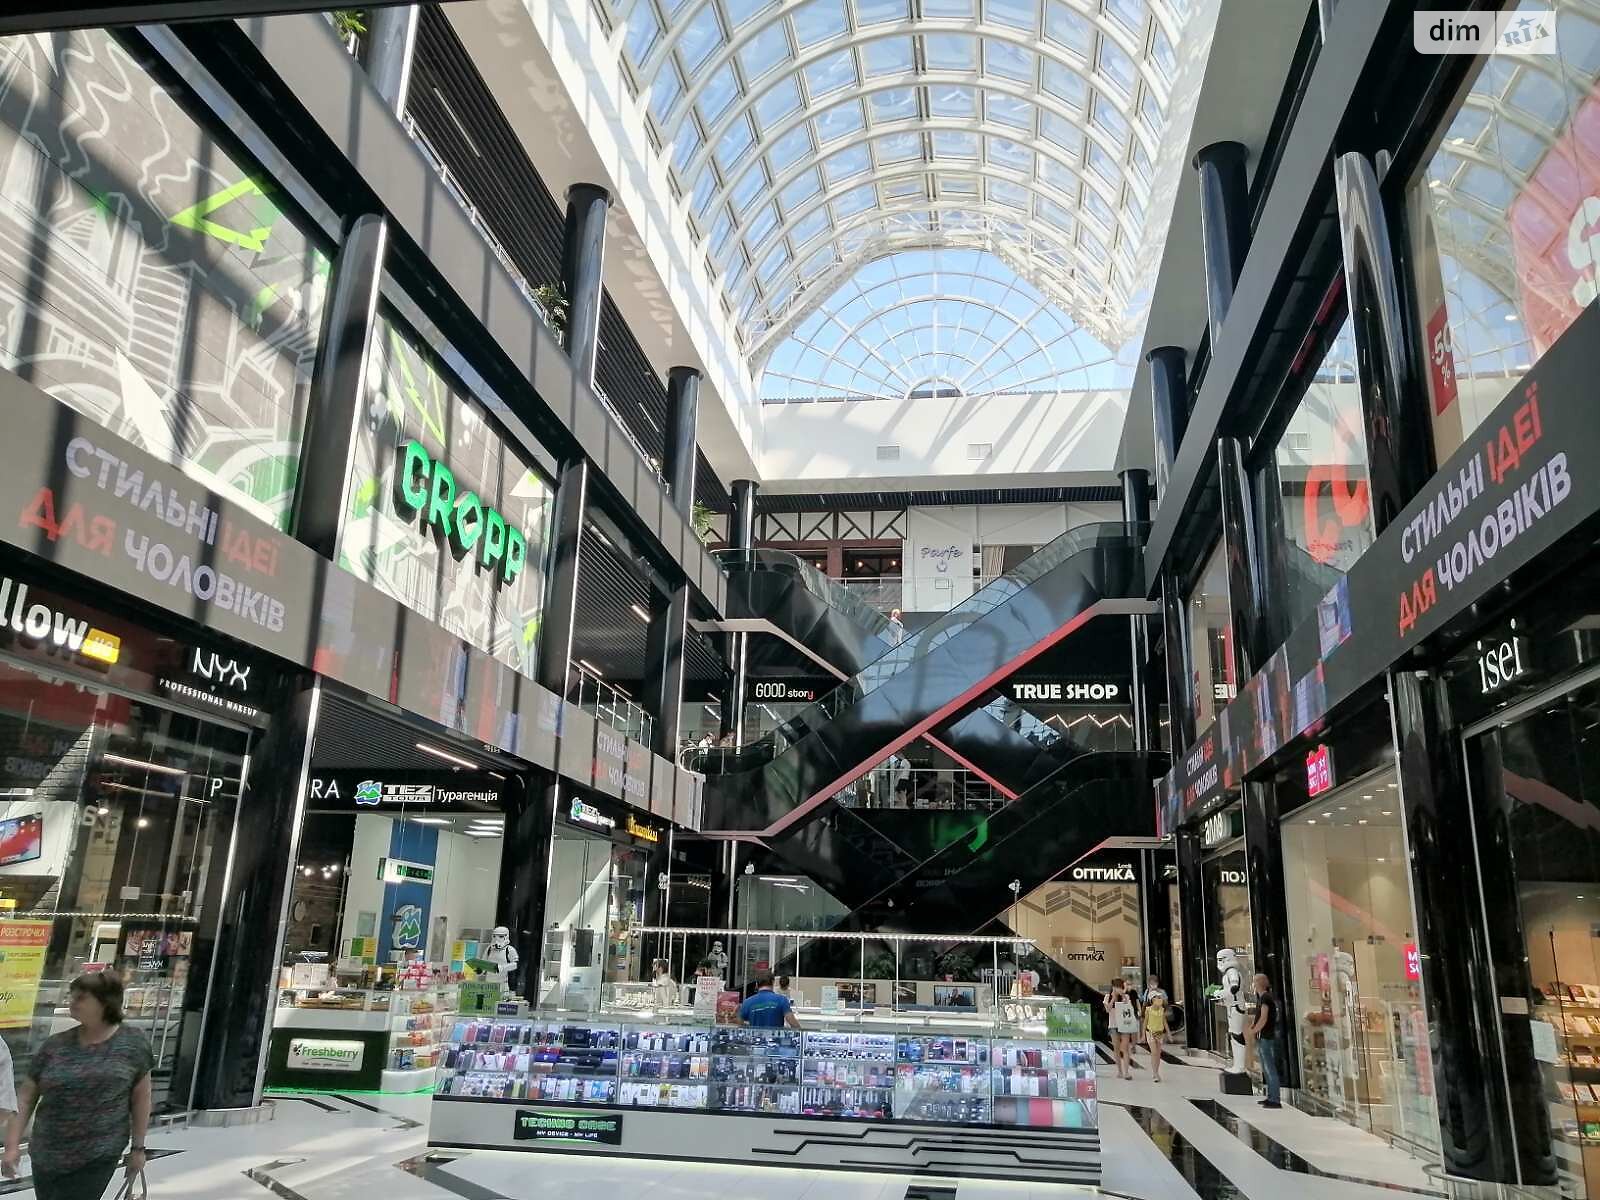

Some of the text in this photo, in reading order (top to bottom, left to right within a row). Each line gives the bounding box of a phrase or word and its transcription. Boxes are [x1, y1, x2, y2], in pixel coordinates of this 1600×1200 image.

[1401, 381, 1544, 564] СТИЛЬНІ ІДЕЇ
[66, 437, 280, 577] СТИЛЬНІ ІДЕЇ
[398, 440, 527, 583] CROPP
[19, 486, 286, 632] ДЛЯ ЧОЛОВІКІВ
[1398, 567, 1436, 638] ДЛЯ
[1436, 451, 1573, 592] ЧОЛОВІКІВ
[193, 647, 250, 691] NYX
[1477, 618, 1523, 693] isei
[160, 678, 258, 717] PROFESSIONAL MAKEUP
[756, 683, 814, 700] GOOD story
[1013, 684, 1119, 700] TRUE SHOP
[383, 784, 432, 794] TEZ
[436, 787, 498, 803] Турагенція
[1073, 867, 1136, 880] ОПТИКА
[1067, 953, 1105, 961] ОПТИКА
[302, 1046, 360, 1059] Freshberry
